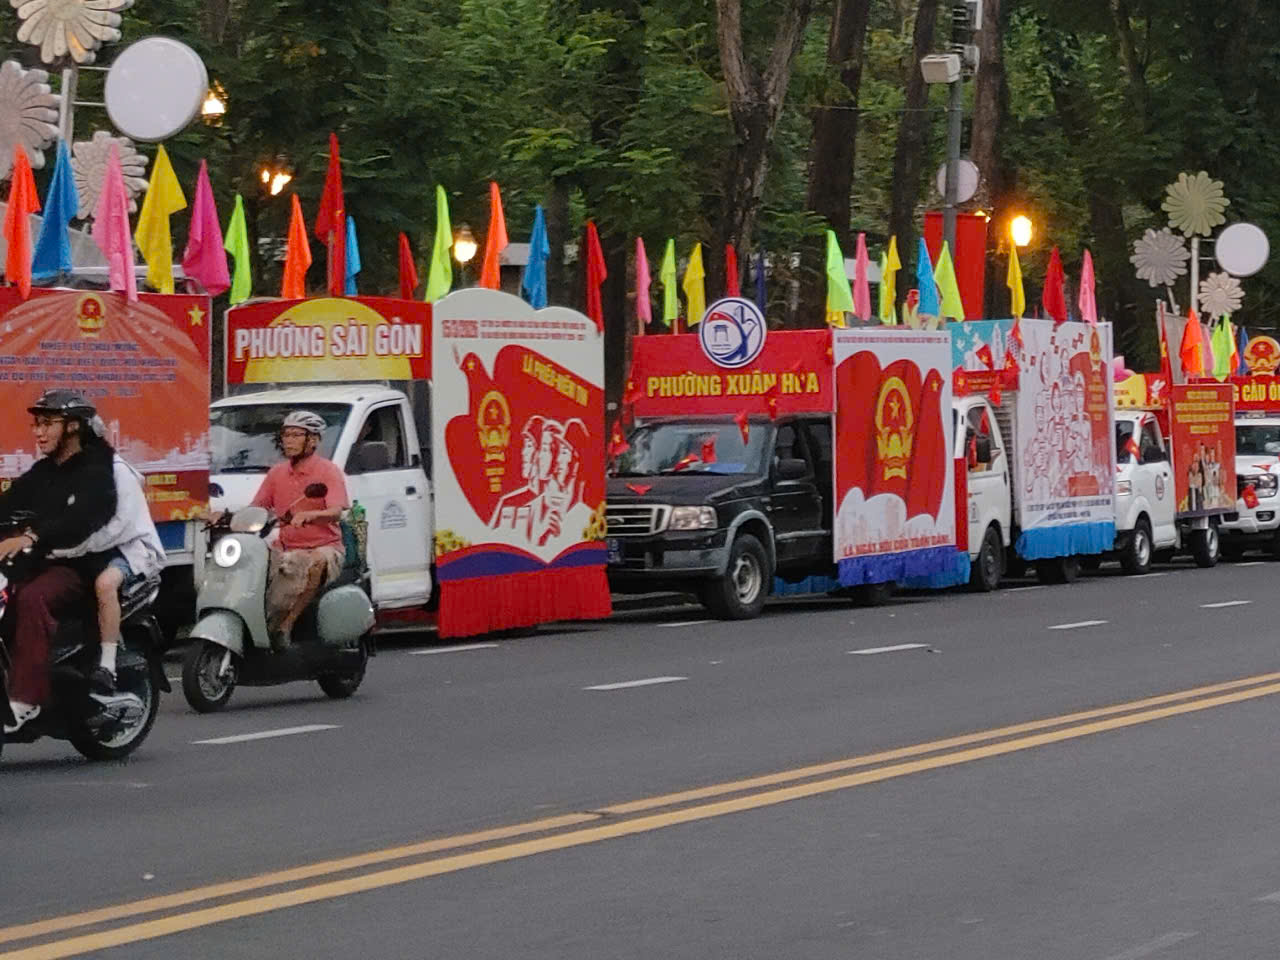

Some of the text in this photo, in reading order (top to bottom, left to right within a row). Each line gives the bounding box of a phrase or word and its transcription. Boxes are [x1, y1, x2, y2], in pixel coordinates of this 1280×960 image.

[234, 320, 324, 360] PHƯỜNG
[331, 318, 368, 357] SÀI
[375, 317, 422, 357] GÒN
[647, 371, 722, 397] PHƯỜNG
